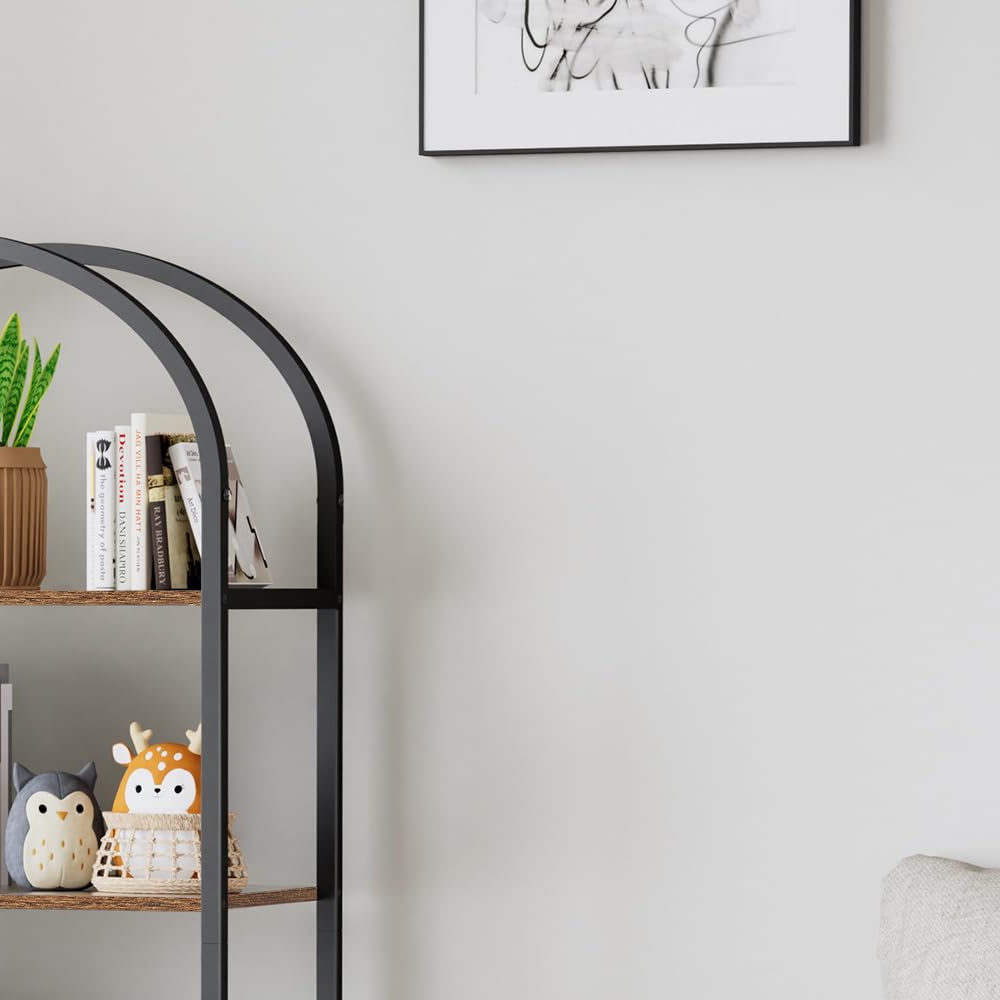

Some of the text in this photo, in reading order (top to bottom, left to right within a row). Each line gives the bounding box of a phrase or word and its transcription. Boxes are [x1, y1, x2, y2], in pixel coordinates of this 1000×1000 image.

[136, 474, 141, 485] HA
[97, 492, 105, 538] geometry
[100, 542, 107, 552] of
[119, 539, 127, 584] SHAPIRO
[153, 506, 167, 585] RAY BRADBURY
